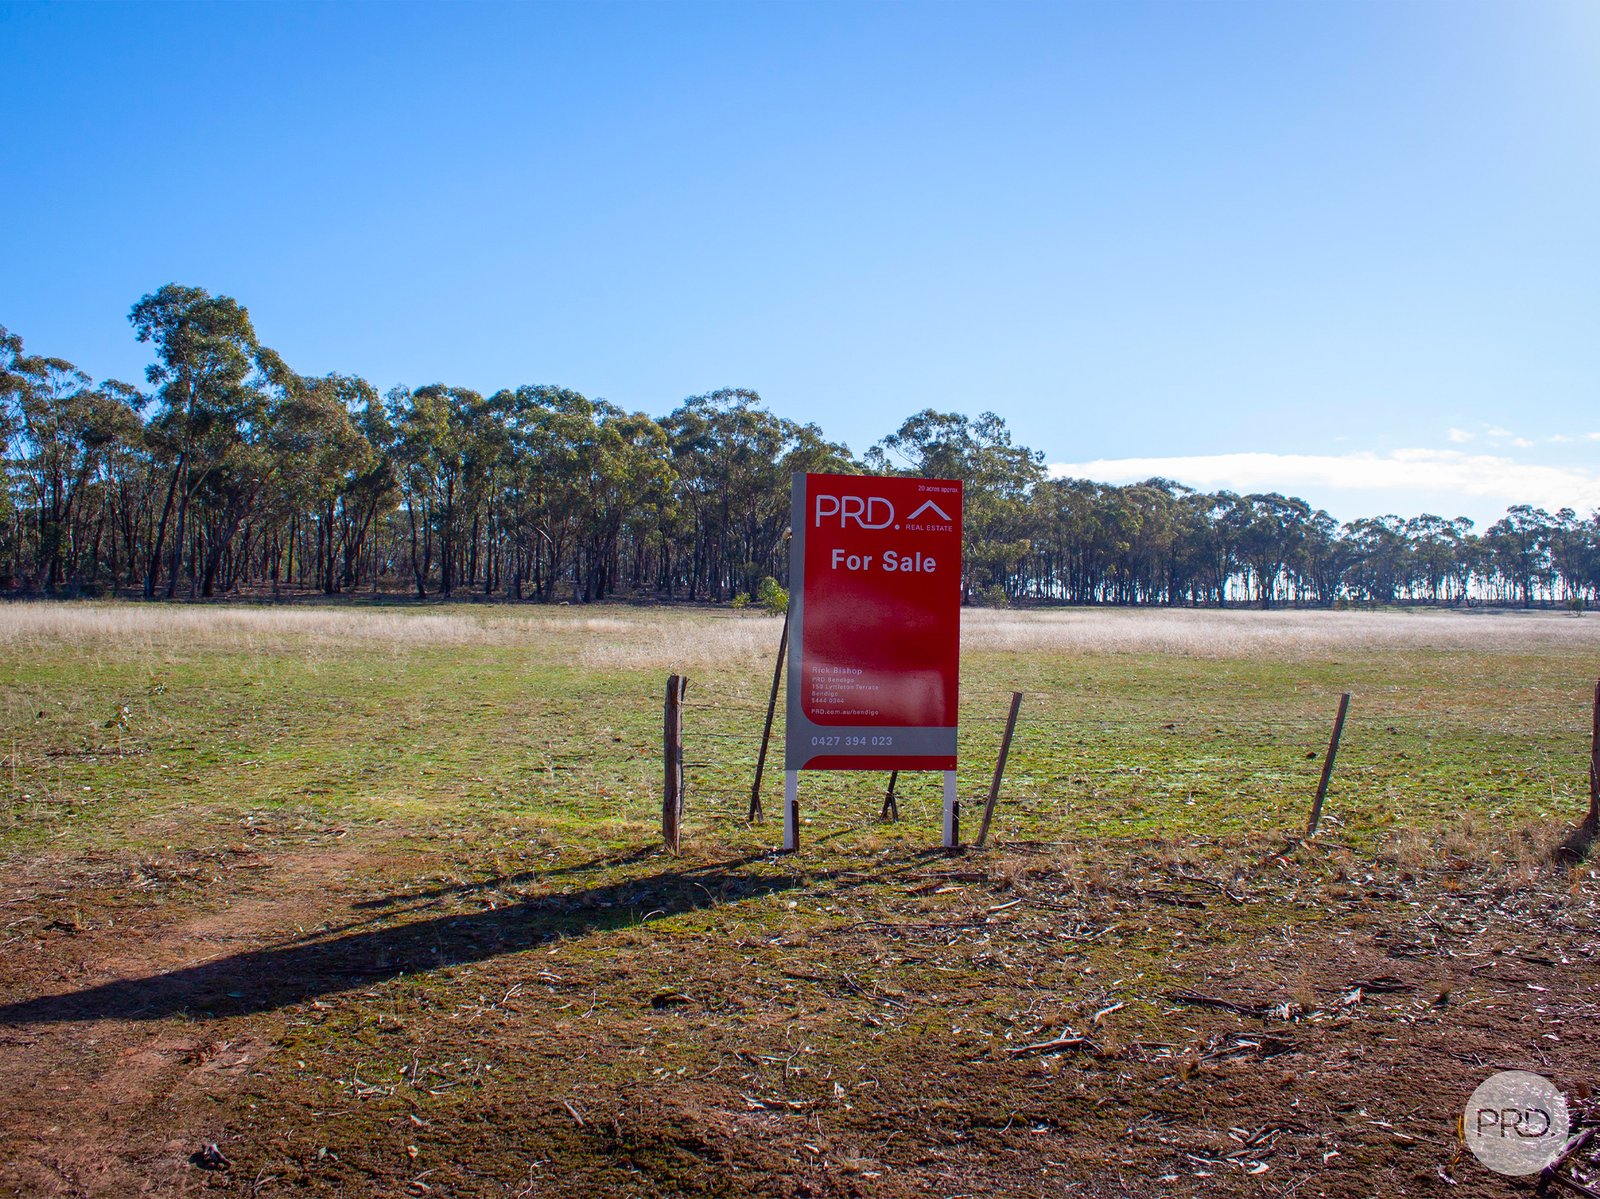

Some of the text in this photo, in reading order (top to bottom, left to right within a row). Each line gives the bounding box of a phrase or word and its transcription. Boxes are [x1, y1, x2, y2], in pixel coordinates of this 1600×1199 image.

[831, 549, 936, 572] For Sale
[812, 666, 862, 676] Rick Bishop
[811, 736, 893, 746] 0427 394 023
